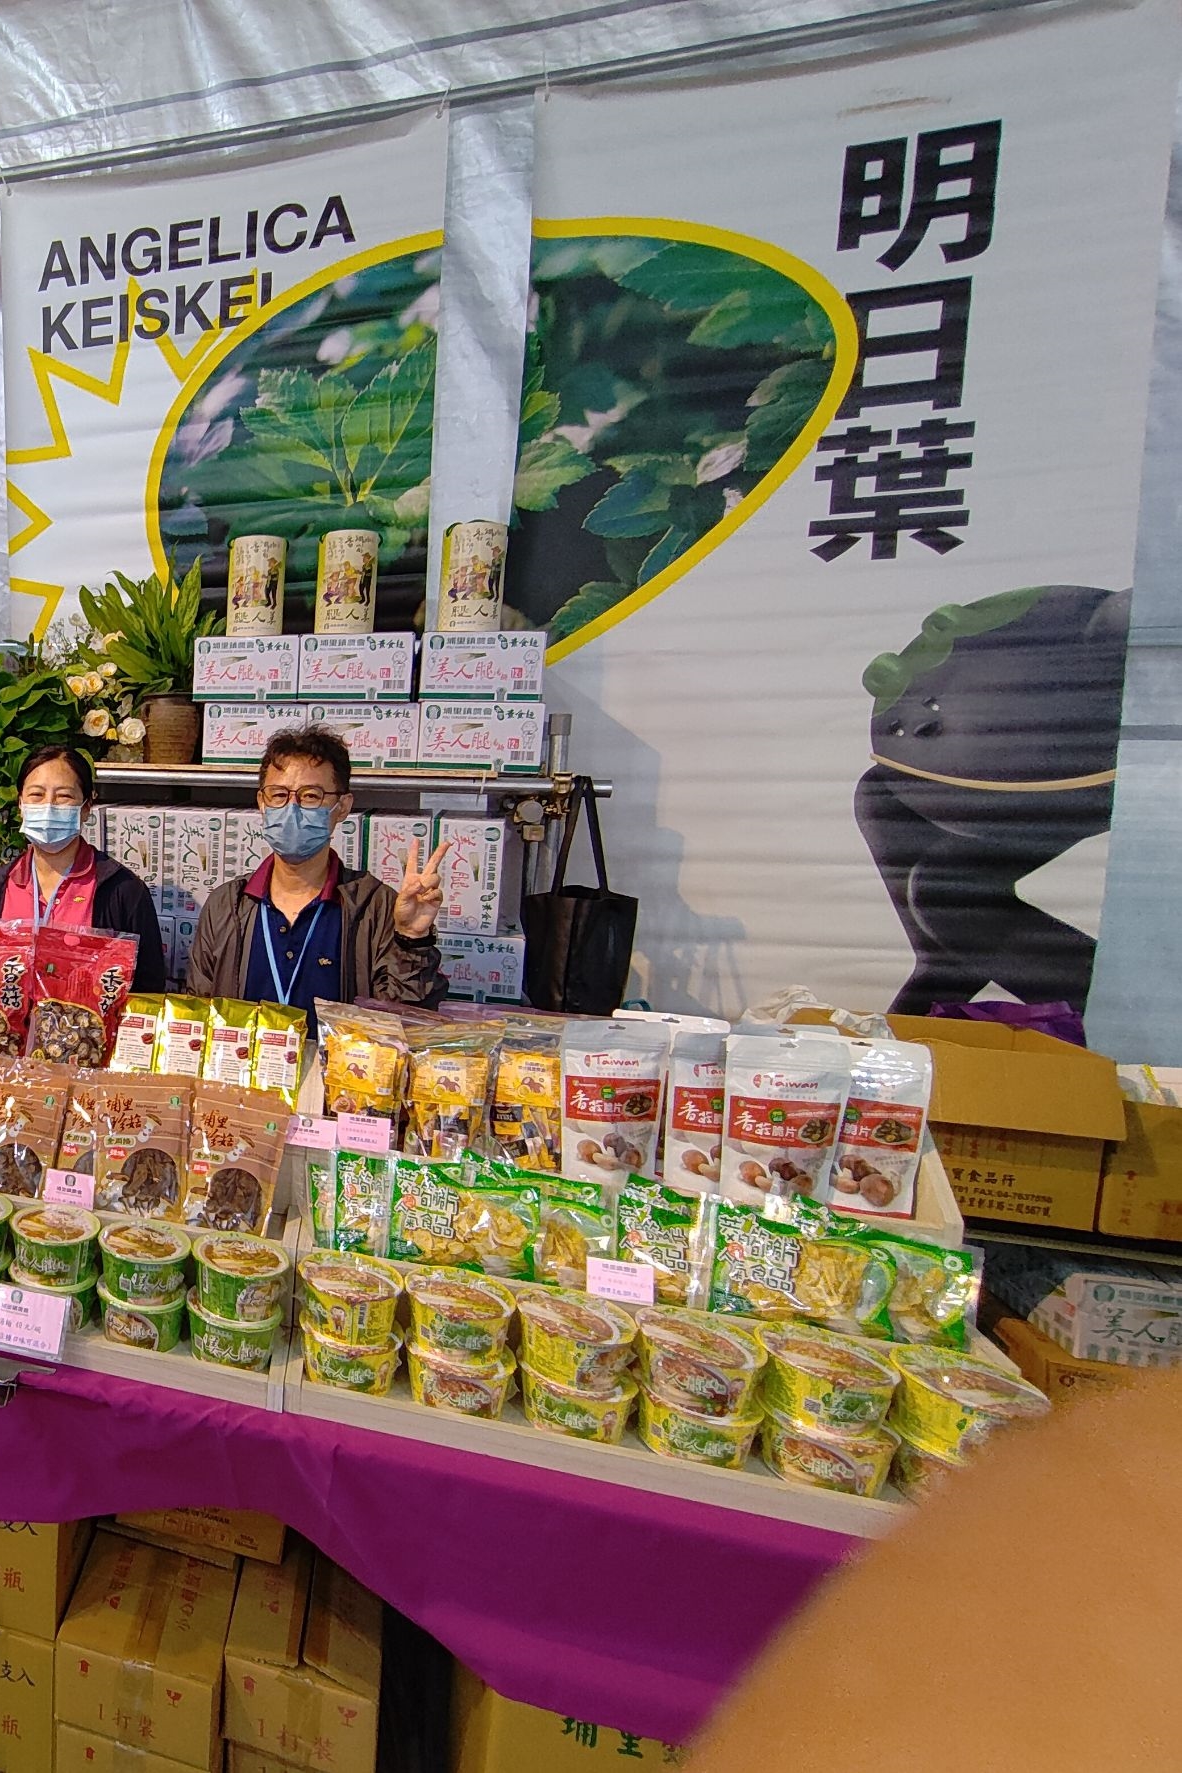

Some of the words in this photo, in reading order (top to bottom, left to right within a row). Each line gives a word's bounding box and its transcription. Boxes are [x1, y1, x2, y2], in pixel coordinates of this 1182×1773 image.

[38, 195, 356, 292] ANGELICA
[42, 272, 273, 354] KEISKEI
[808, 118, 1002, 563] 明日葉
[199, 660, 255, 684] 美人腿
[306, 659, 365, 682] 美人腿
[430, 657, 495, 682] 美人腿
[427, 727, 491, 752] 美人腿
[2, 957, 26, 1009] 香菇
[591, 1053, 640, 1067] Taiwan
[763, 1073, 819, 1089] Taiwan
[570, 1089, 623, 1112] 香菇脆片
[734, 1110, 798, 1138] 香菇脆片
[948, 1167, 1016, 1188] 寶食品行
